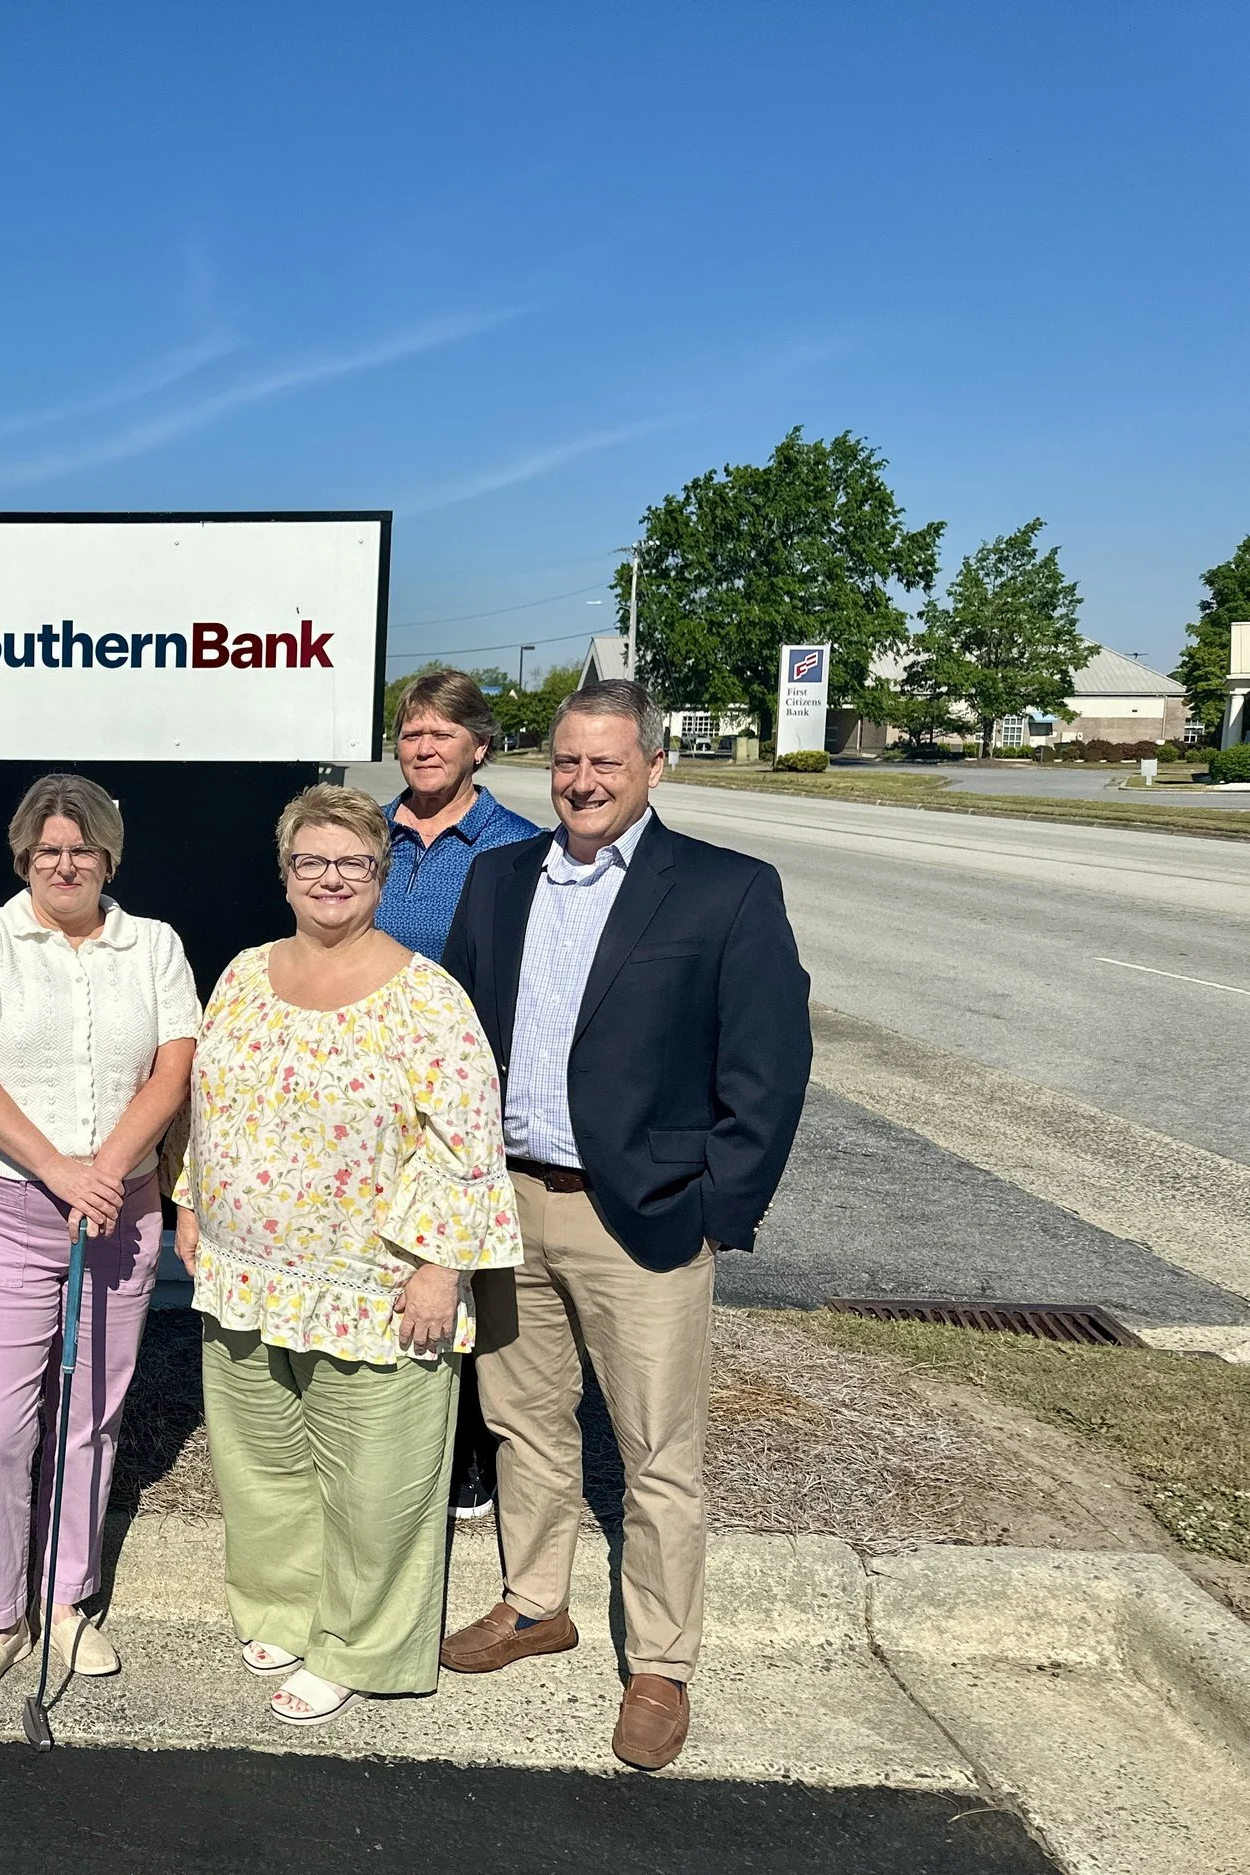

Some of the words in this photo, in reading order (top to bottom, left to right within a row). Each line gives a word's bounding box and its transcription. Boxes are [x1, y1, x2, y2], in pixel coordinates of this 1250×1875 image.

[787, 687, 807, 696] First
[785, 697, 822, 706] Citizens
[786, 708, 810, 717] Bank
